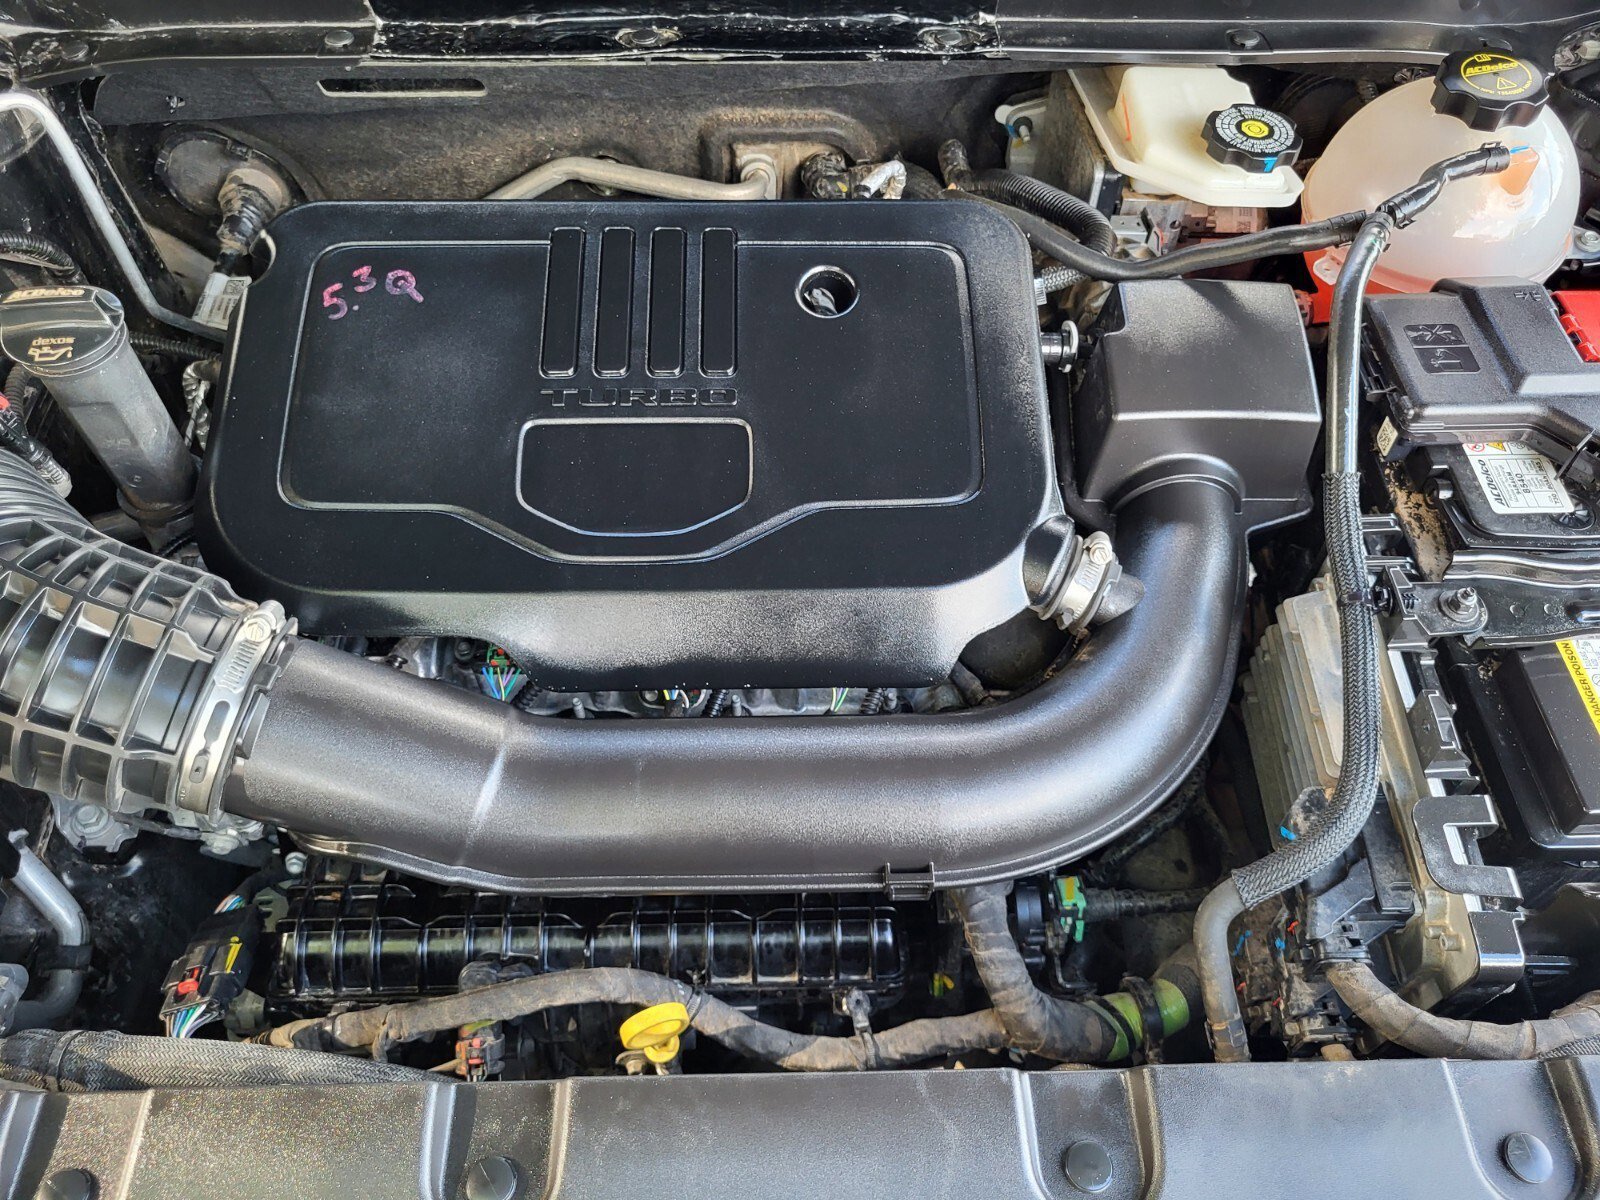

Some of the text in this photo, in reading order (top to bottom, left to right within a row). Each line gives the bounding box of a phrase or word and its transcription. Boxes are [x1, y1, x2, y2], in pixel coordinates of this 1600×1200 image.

[1465, 62, 1519, 74] ACDelco
[32, 337, 76, 346] dexos
[540, 388, 738, 406] TURBO
[1478, 459, 1506, 506] ACDelco
[1515, 473, 1531, 494] 8540
